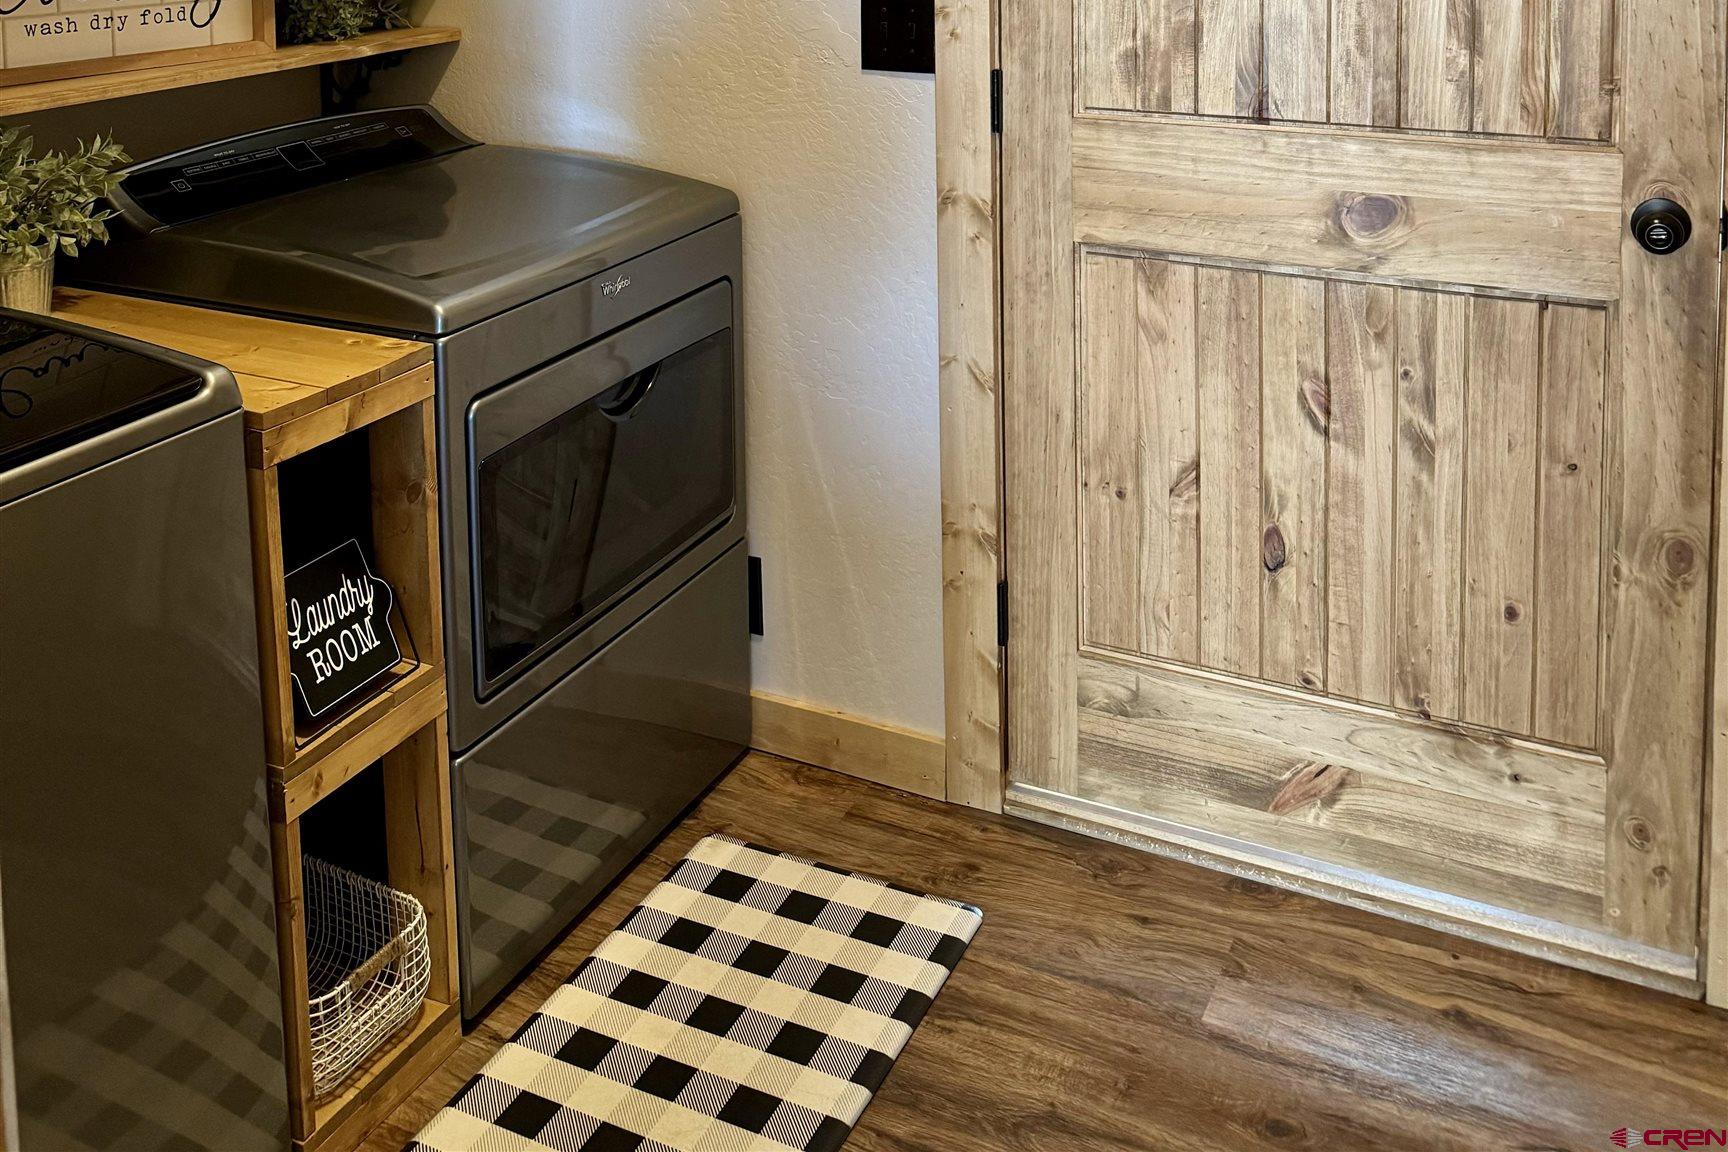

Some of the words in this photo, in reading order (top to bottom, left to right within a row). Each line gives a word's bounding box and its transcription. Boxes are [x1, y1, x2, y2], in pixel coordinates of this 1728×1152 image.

[24, 17, 78, 37] wash
[90, 14, 129, 32] dry
[140, 6, 187, 26] fold
[287, 573, 375, 649] Laundry
[306, 615, 381, 684] ROOM
